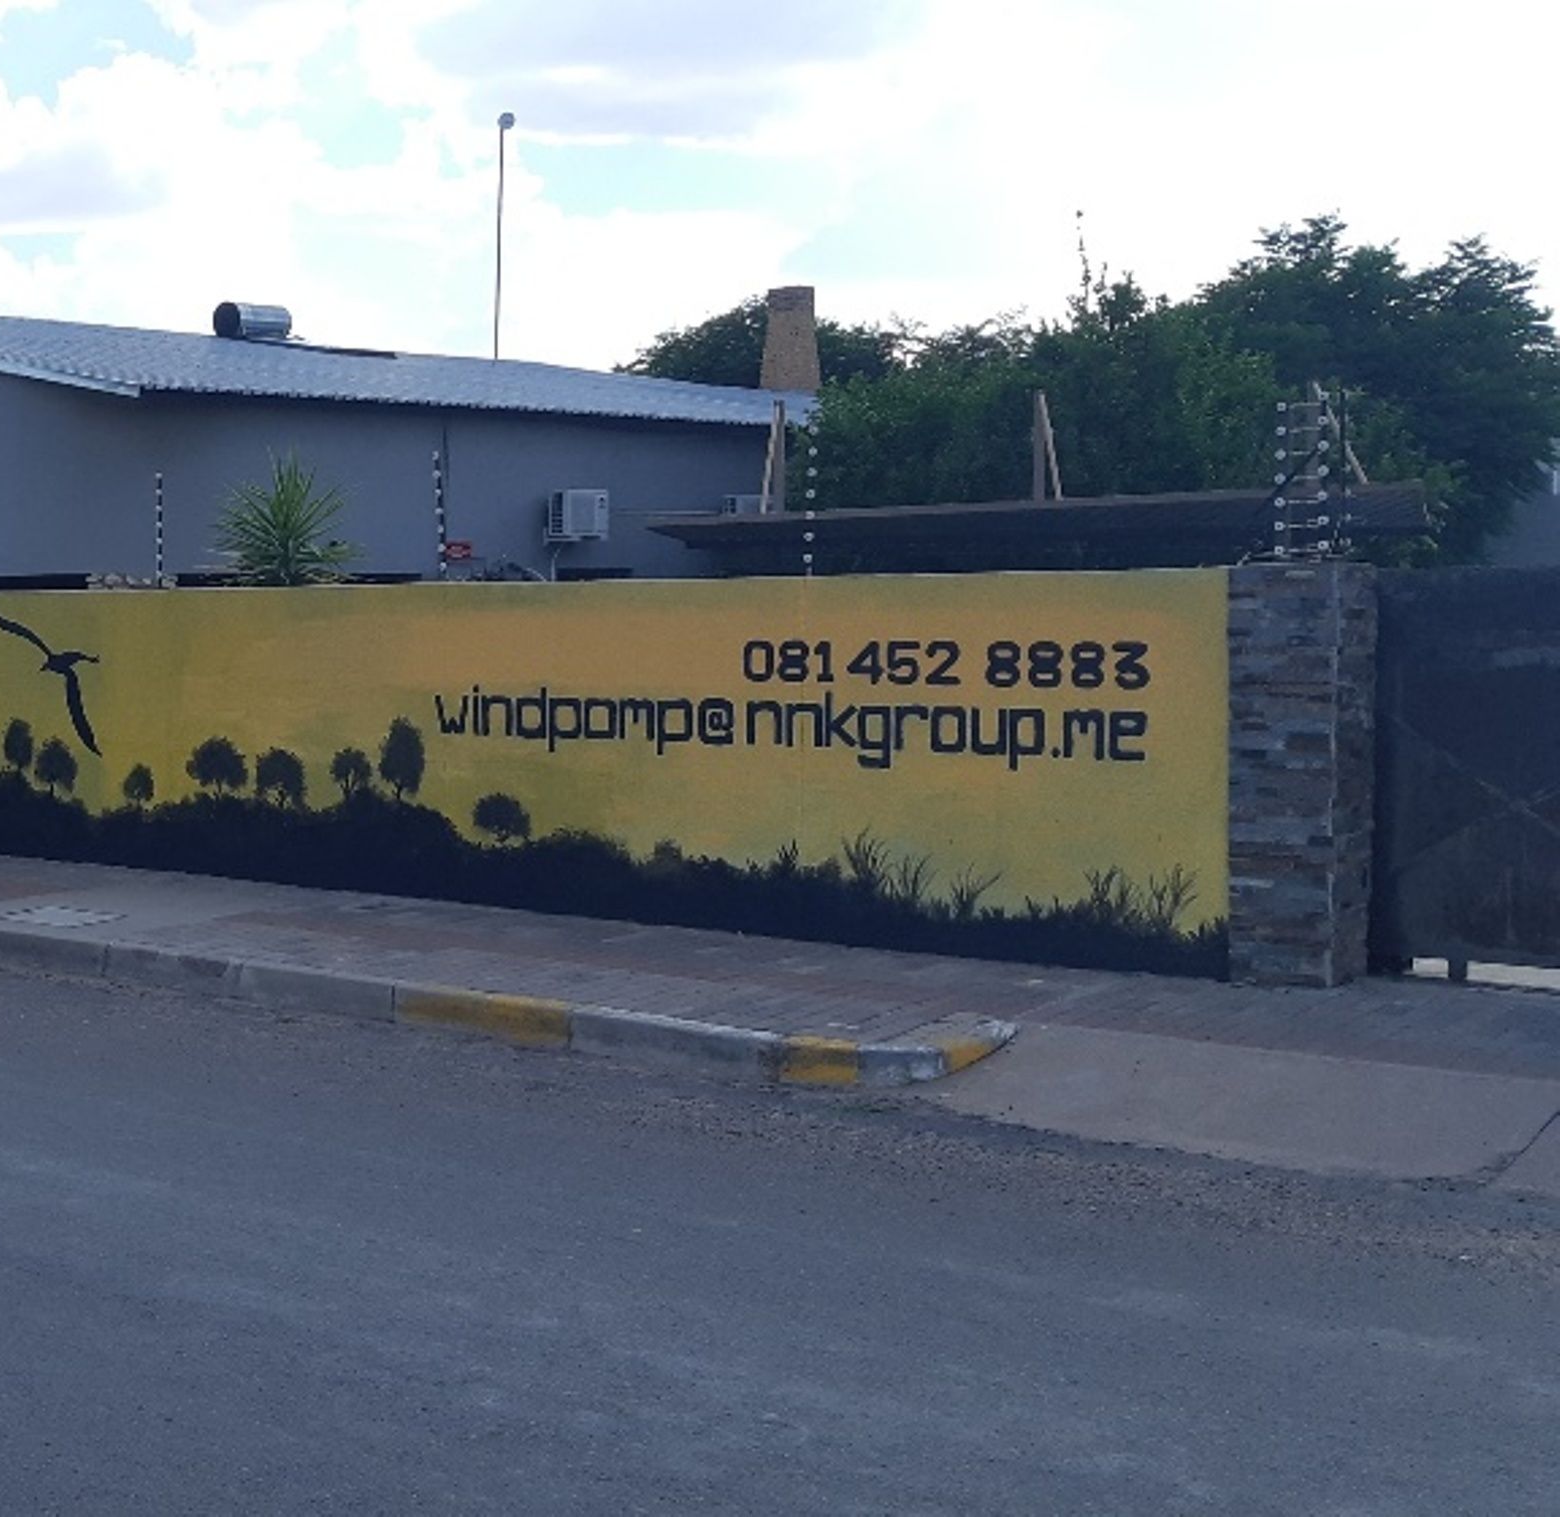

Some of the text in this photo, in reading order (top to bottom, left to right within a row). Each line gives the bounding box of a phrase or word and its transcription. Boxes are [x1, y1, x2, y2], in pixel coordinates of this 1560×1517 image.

[743, 640, 1151, 690] 081 452 8883
[434, 684, 1149, 771] windpomp@nnkgroup.me
